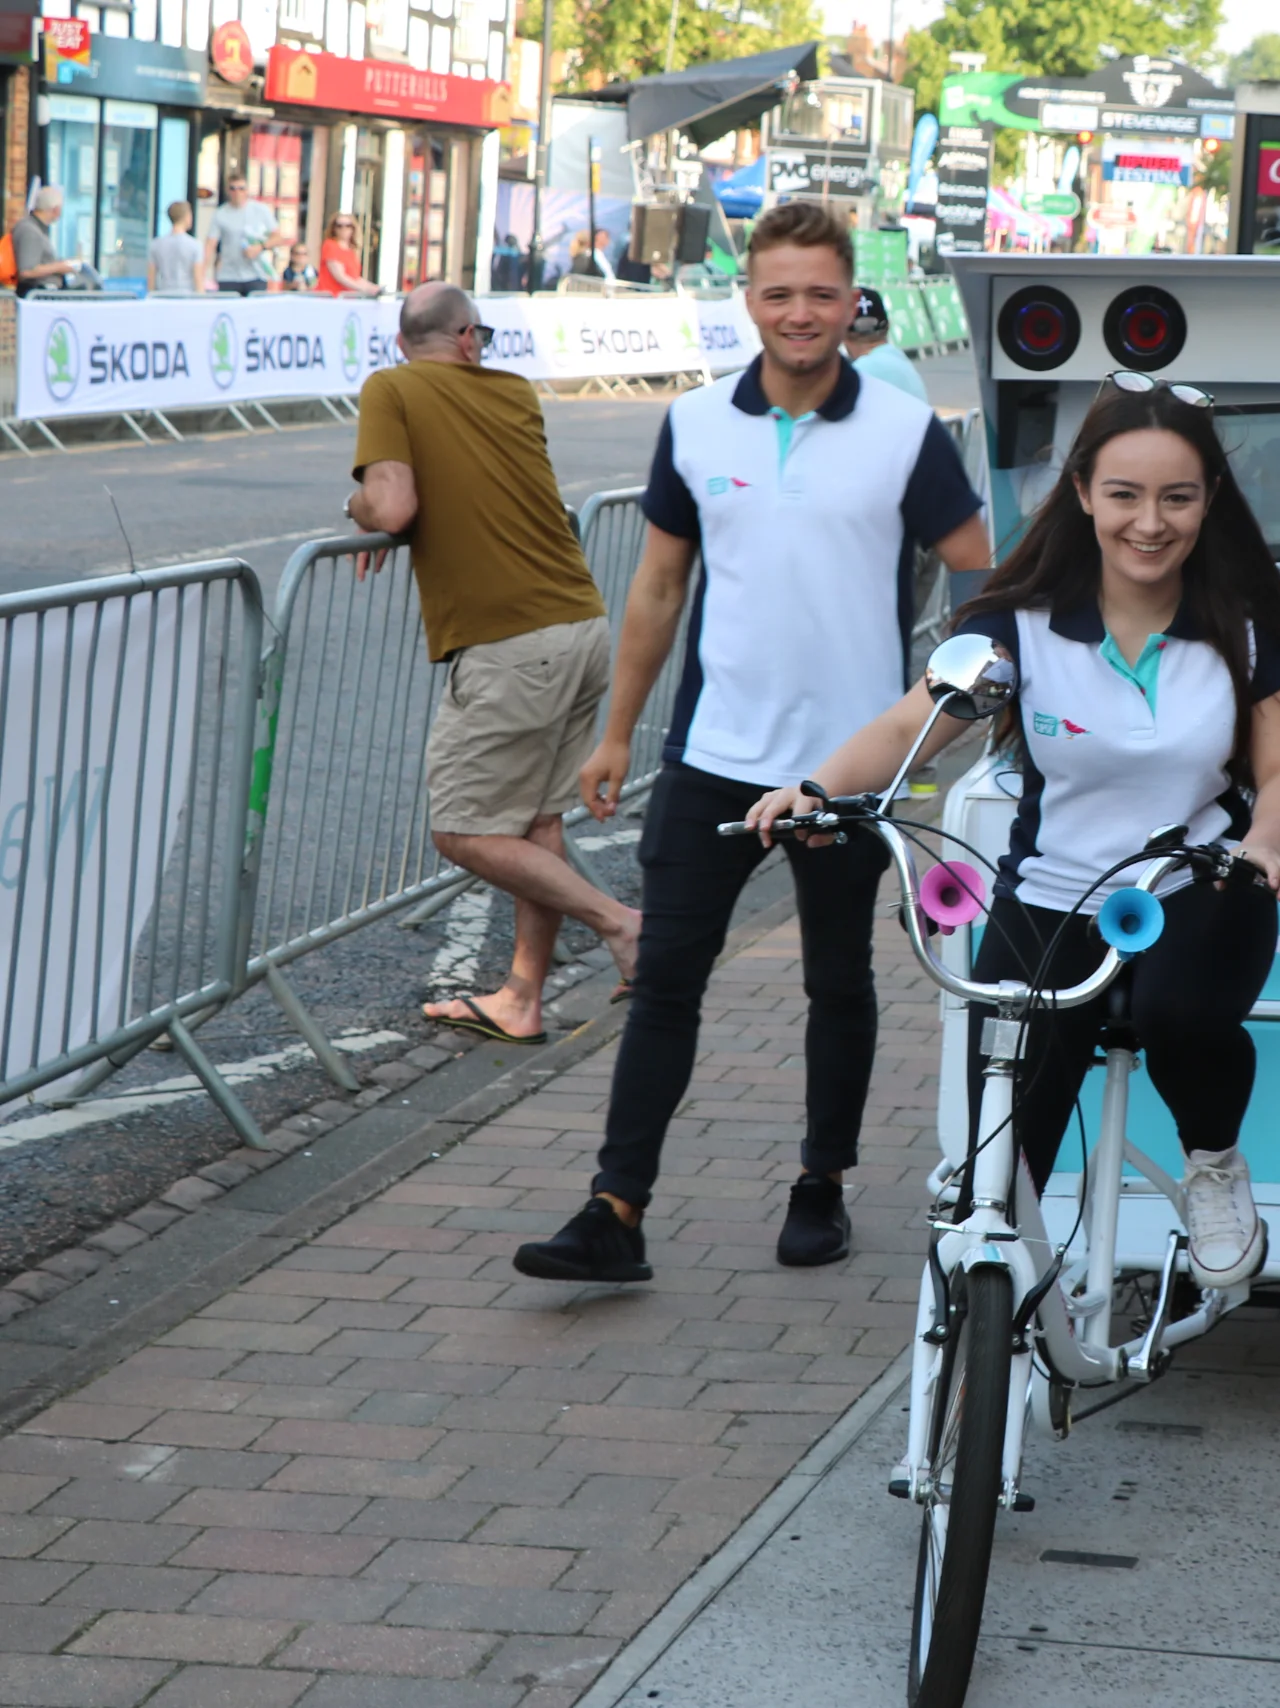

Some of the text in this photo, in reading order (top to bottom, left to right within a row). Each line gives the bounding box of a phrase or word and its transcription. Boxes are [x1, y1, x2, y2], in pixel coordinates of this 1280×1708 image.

[50, 20, 85, 35] JUST
[56, 35, 84, 49] EAT
[1101, 111, 1199, 133] STEVENAGE
[1112, 166, 1183, 186] FESTINA
[245, 328, 327, 373] ŠKODA
[368, 326, 403, 367] ŠKO
[580, 321, 662, 355] ŠKODA
[89, 334, 191, 385] ŠKODA
